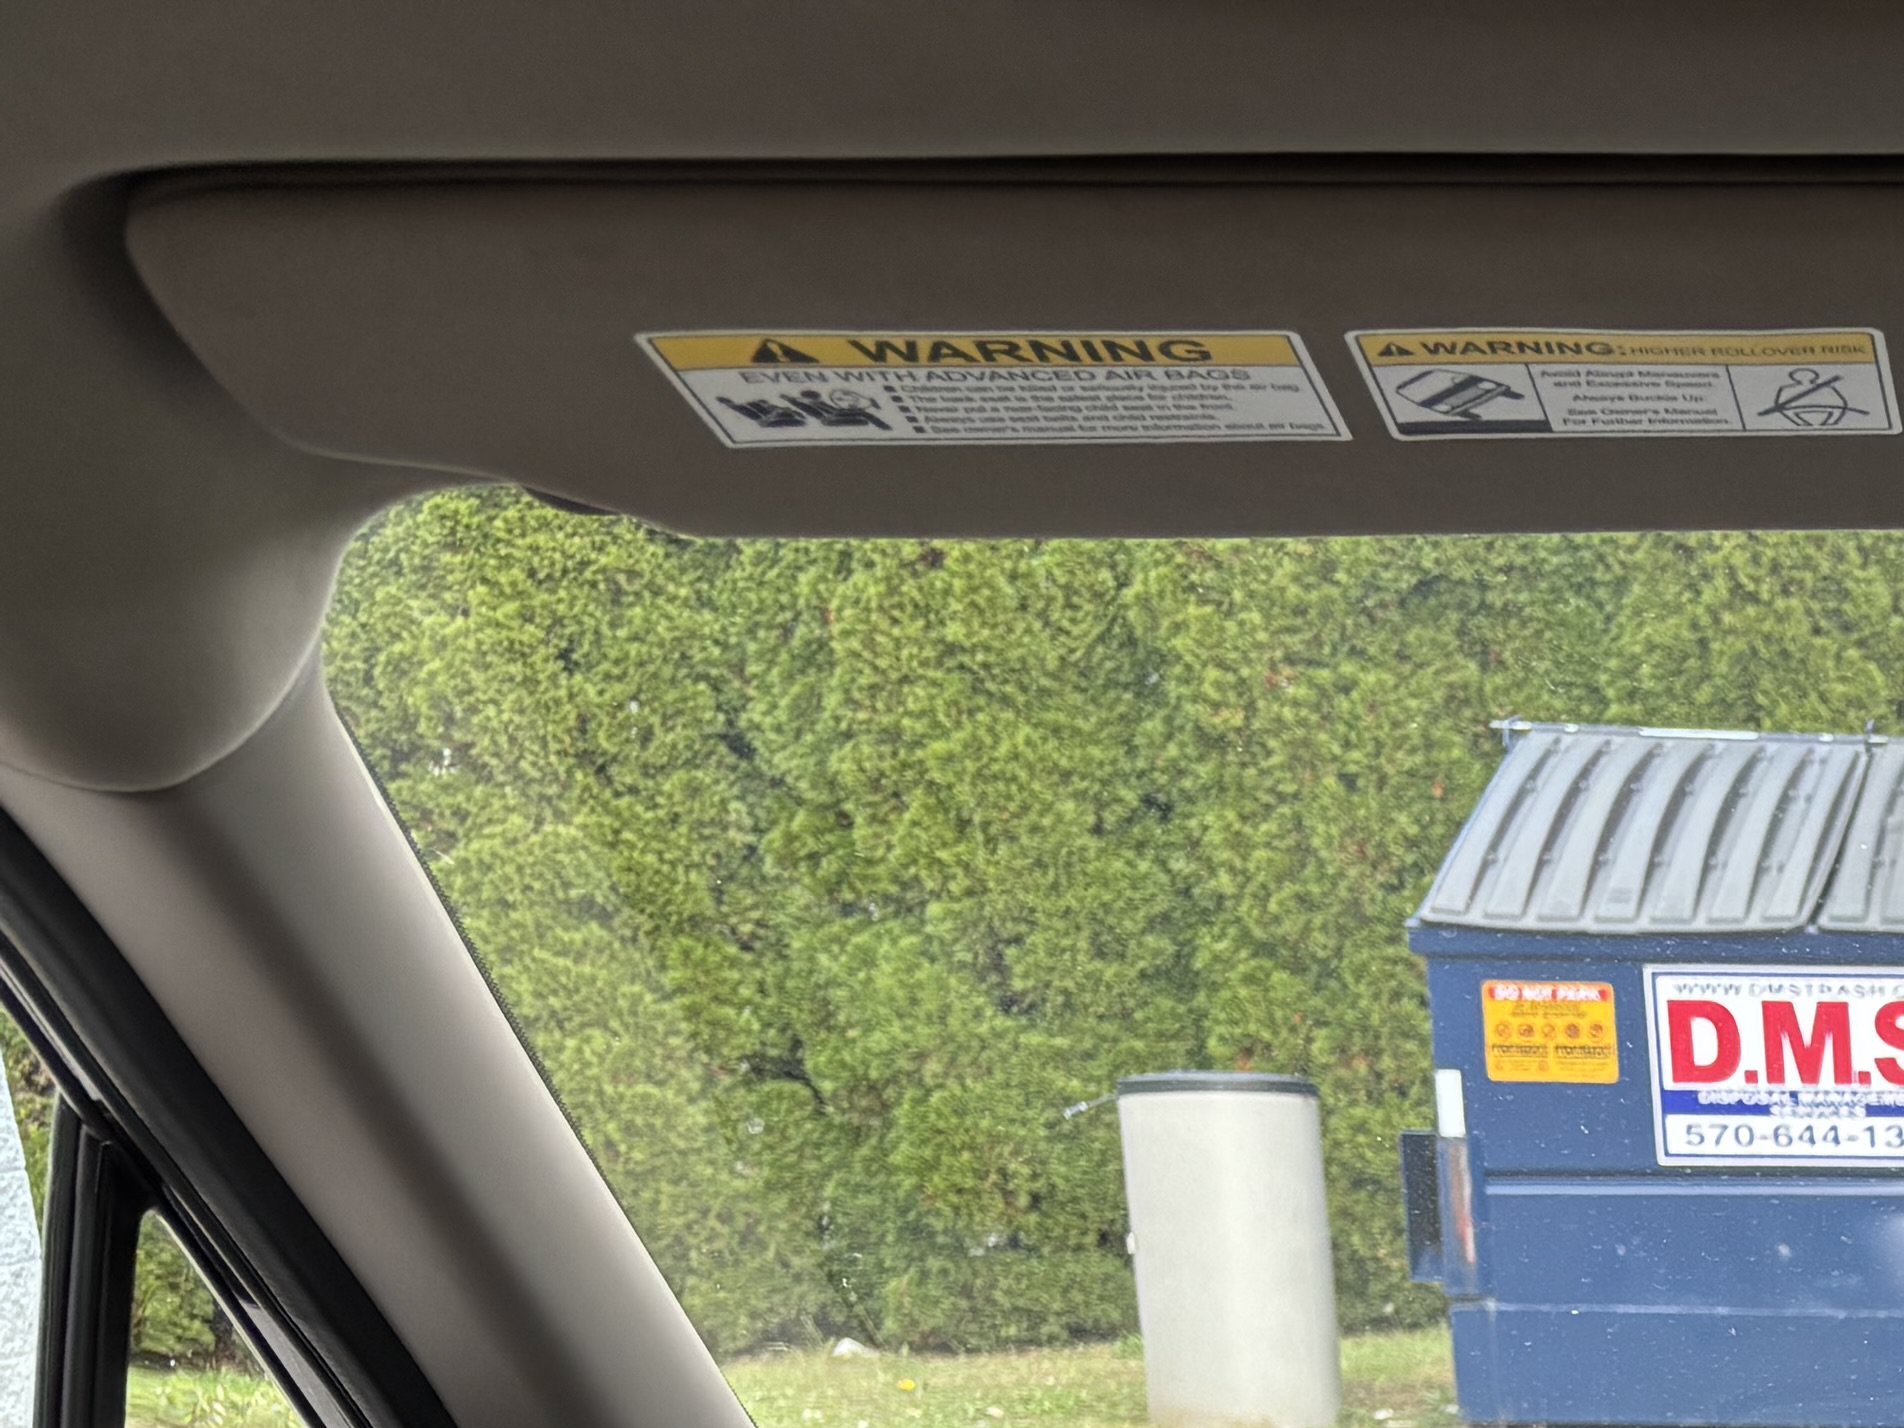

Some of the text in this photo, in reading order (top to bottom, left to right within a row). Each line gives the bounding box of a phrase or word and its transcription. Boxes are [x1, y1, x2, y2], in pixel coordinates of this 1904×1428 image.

[847, 339, 1213, 364] WARNING
[1631, 346, 1706, 357] HIGHER
[1710, 347, 1815, 357] ROLLOVER
[740, 369, 1252, 384] EVEN WITH ADVANCED AIR BAGS
